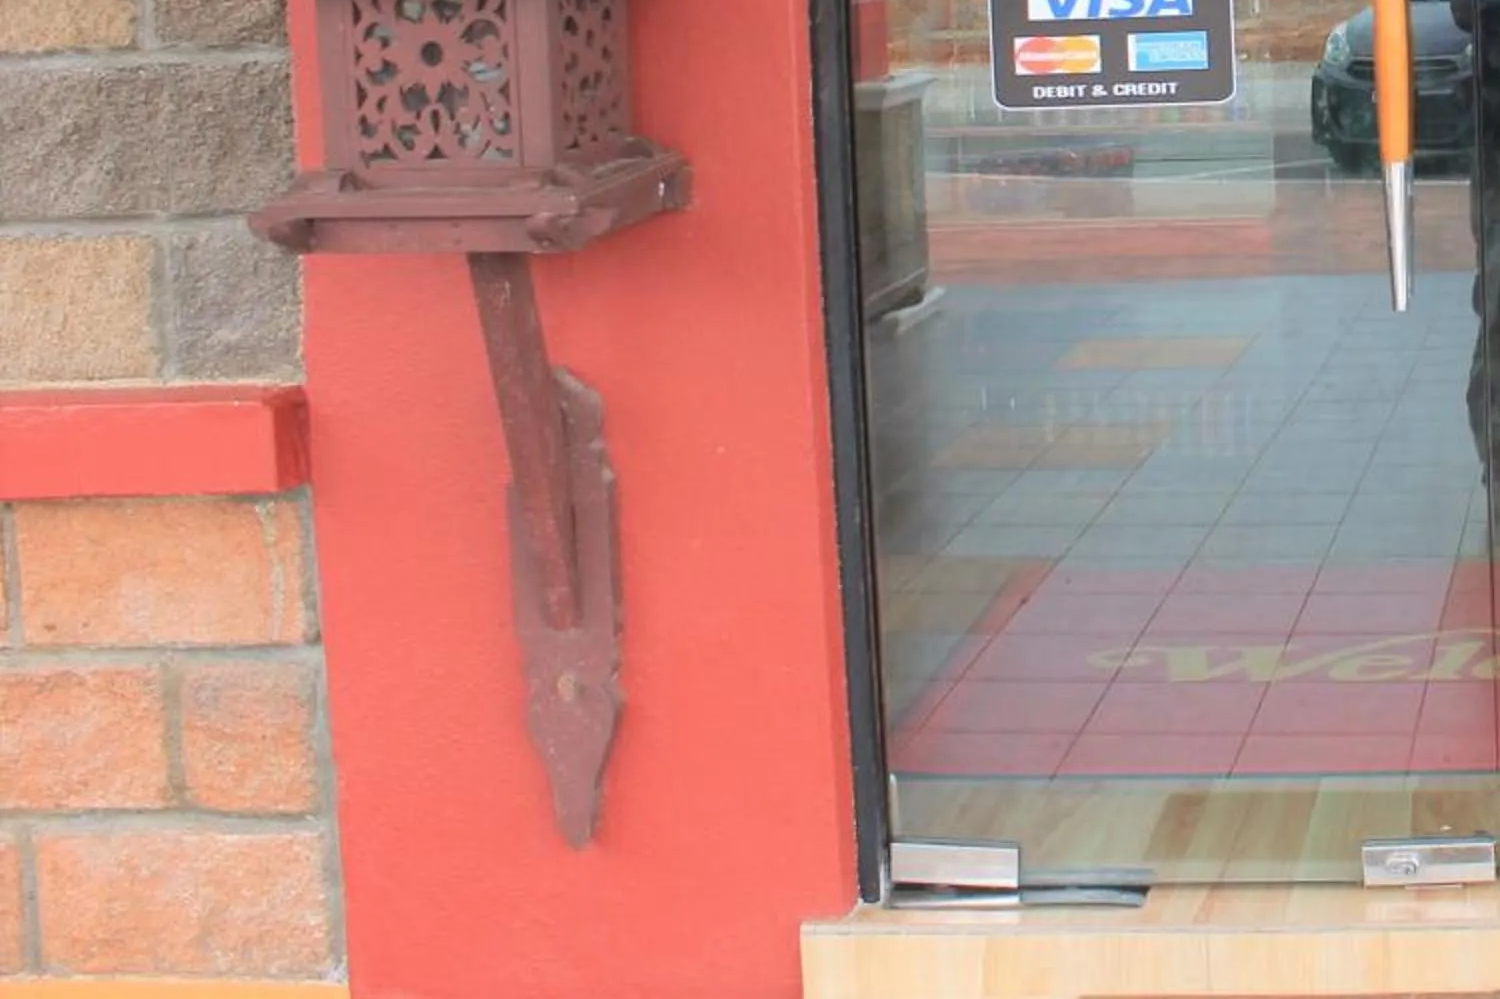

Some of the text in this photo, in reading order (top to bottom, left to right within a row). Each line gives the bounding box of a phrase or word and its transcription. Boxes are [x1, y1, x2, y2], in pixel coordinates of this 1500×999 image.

[1032, 82, 1178, 99] DEBIT & CREDIT
